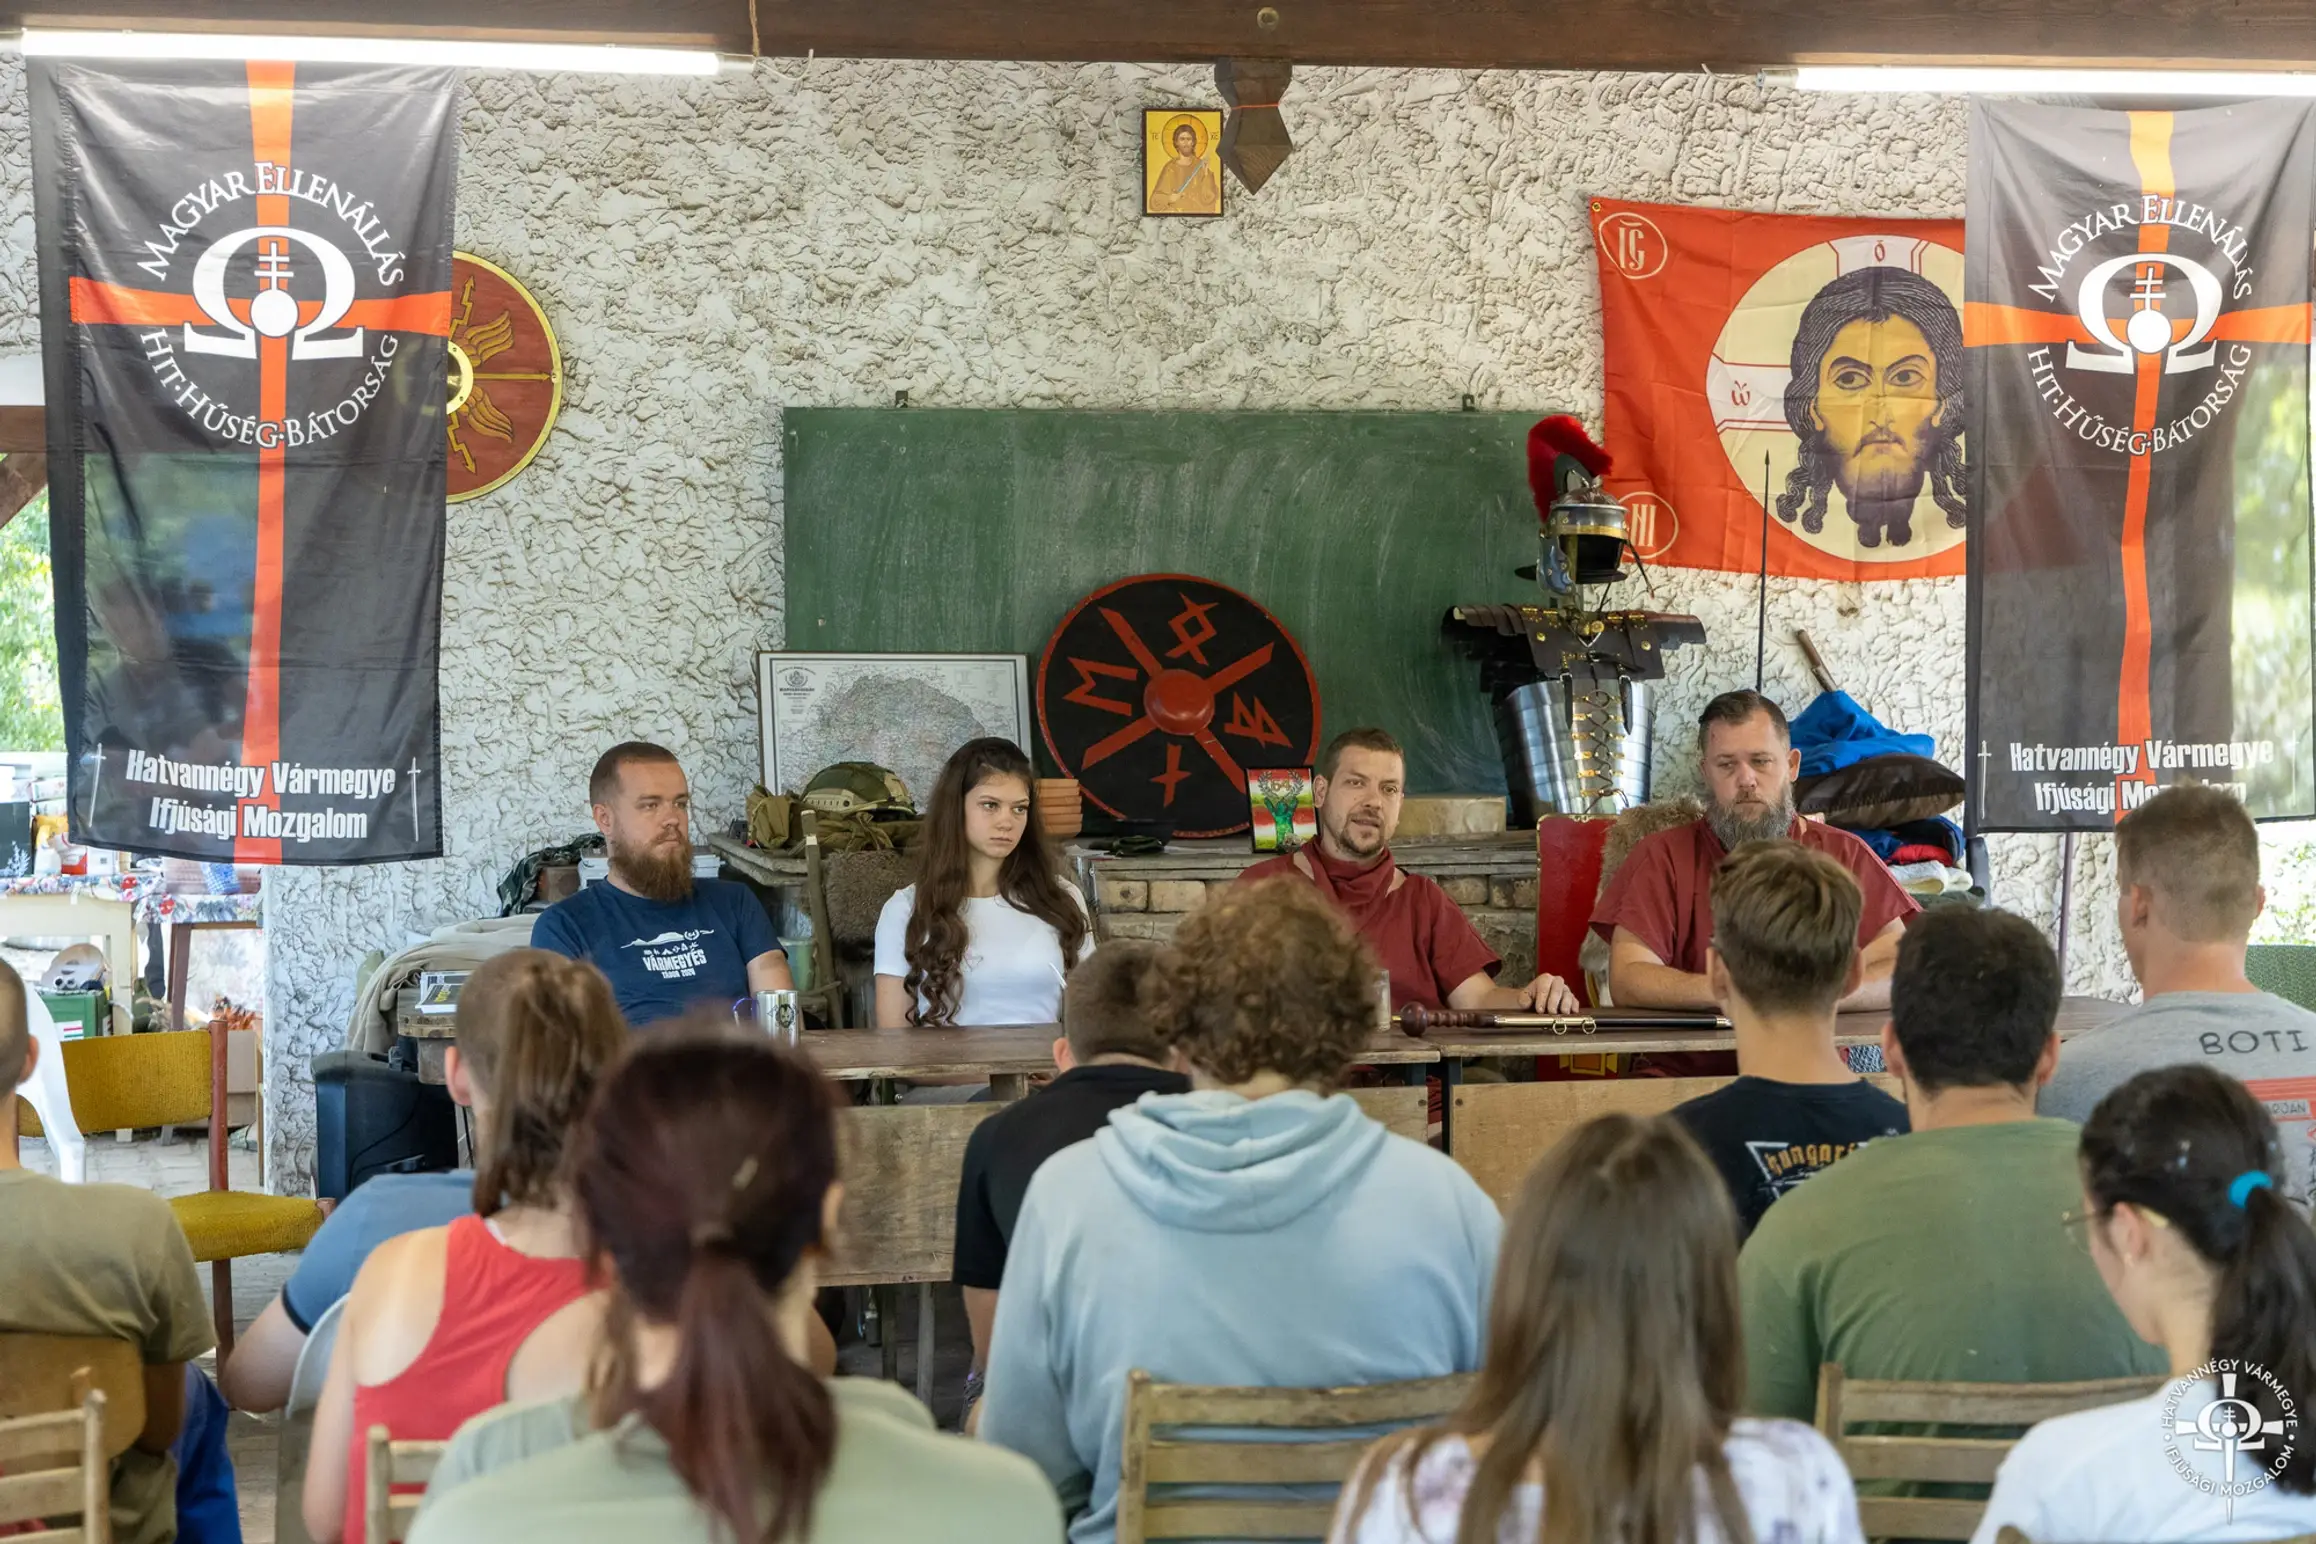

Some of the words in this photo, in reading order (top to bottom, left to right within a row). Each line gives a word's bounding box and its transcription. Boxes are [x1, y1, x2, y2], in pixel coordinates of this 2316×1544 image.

[137, 171, 256, 281] MAGYAR
[254, 162, 406, 286] ELLENÁLLÁS
[2028, 203, 2141, 303] MAGYAR
[2140, 194, 2253, 300] ELLENÁLLÁS
[284, 334, 399, 447] BÁTORSÁG
[2152, 344, 2252, 453] BÁTORSÁG
[126, 749, 266, 798] Hatvannégy
[271, 761, 396, 799] Vármegye
[2010, 741, 2141, 774] Hatvannégy
[2144, 739, 2275, 770] Vármegye
[149, 796, 238, 841] Ifjúsági
[243, 805, 368, 842] Mozgalom
[2034, 781, 2117, 815] Ifjúsági
[2199, 1030, 2309, 1055] BOTI
